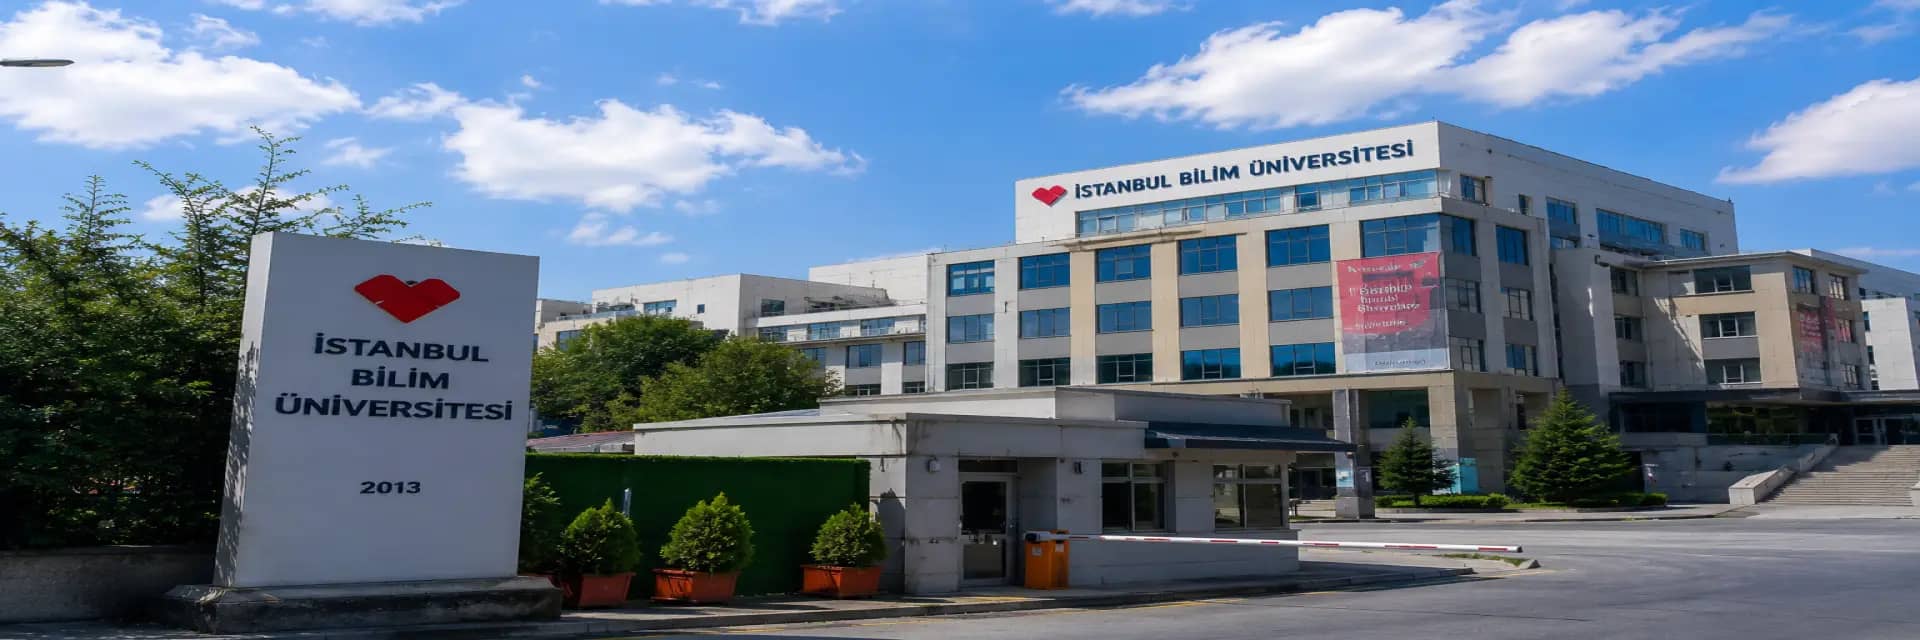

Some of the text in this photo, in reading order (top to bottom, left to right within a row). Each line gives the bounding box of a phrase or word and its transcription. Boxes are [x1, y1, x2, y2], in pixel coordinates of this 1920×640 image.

[1075, 139, 1413, 200] İSTANBUL BİLİM ÜNİVERSİTESİ
[313, 332, 489, 363] İSTANBUL
[351, 366, 449, 390] BİLİM
[275, 393, 512, 421] ÜNİVERSİTESİ
[359, 481, 421, 494] 2013
